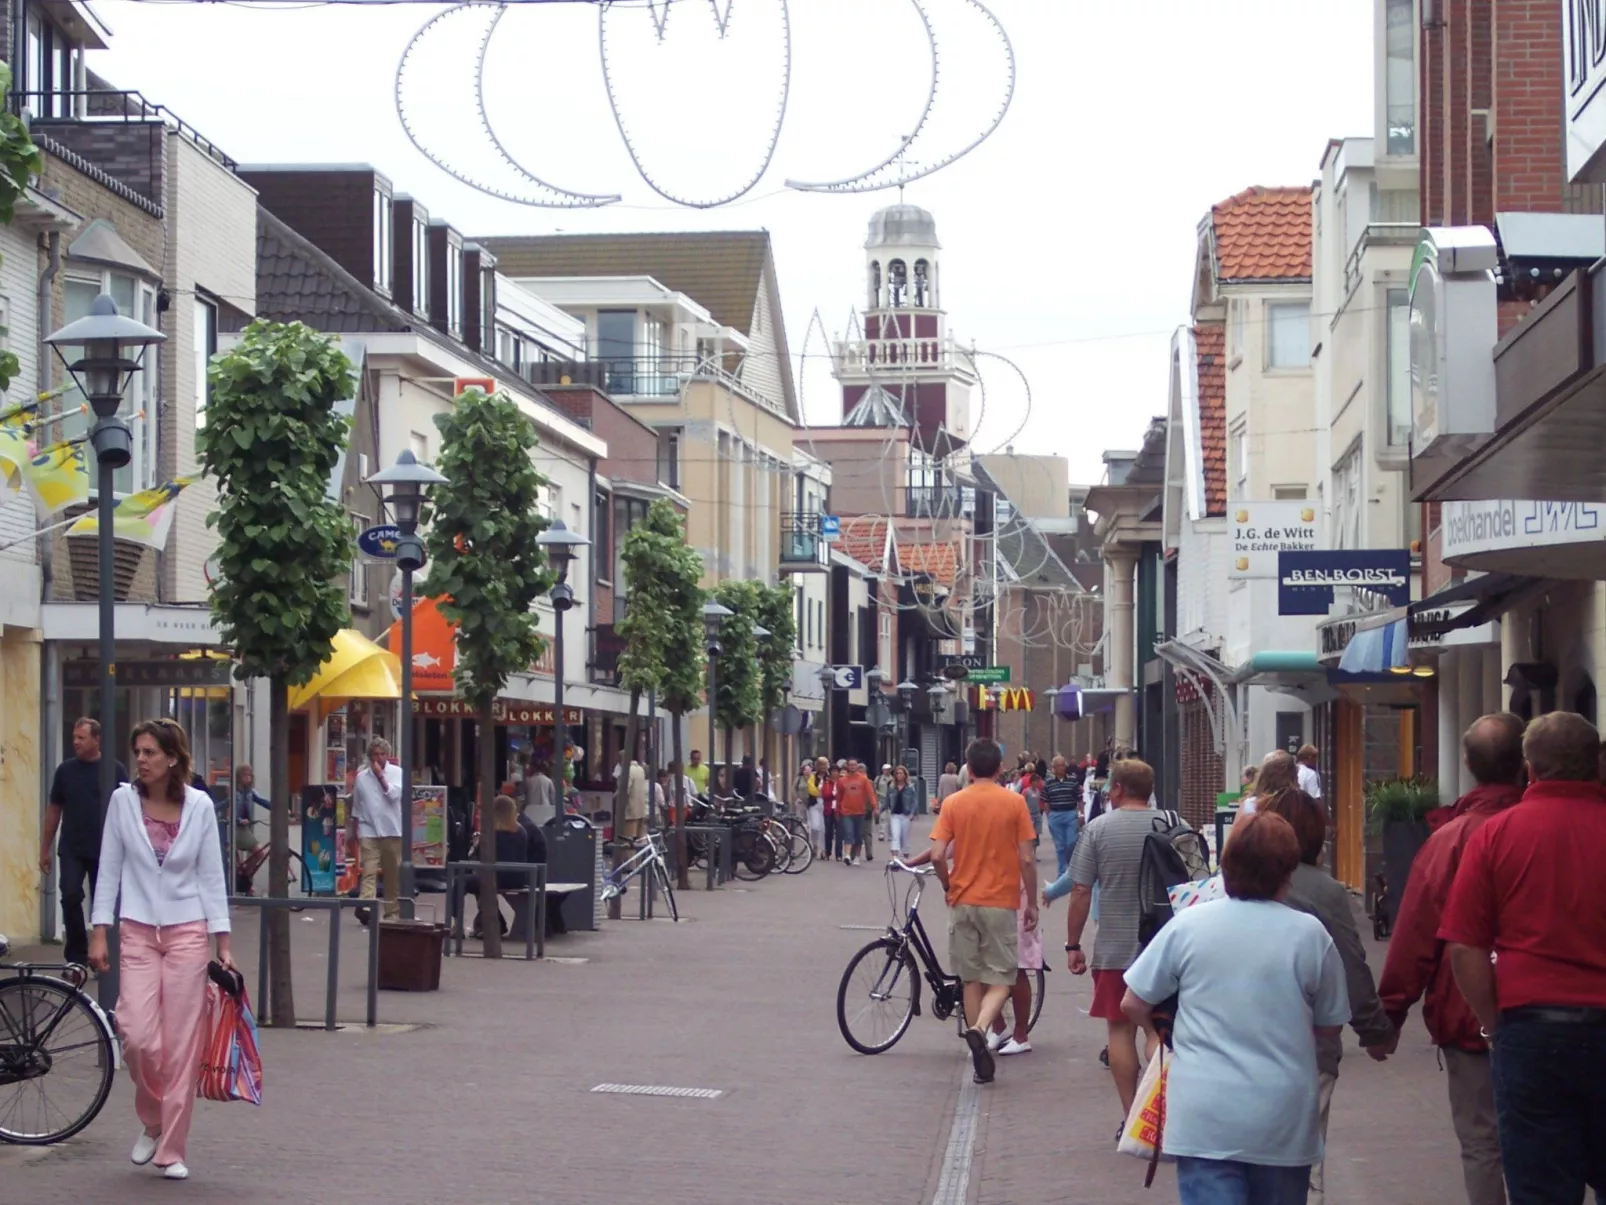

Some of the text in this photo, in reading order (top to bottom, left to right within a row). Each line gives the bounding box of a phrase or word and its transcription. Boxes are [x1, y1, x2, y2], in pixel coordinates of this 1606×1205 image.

[368, 530, 402, 541] CAME
[1234, 526, 1315, 540] J.G. de Witt
[1235, 541, 1315, 551] De Echte Bakker
[412, 700, 500, 714] BLOKKR
